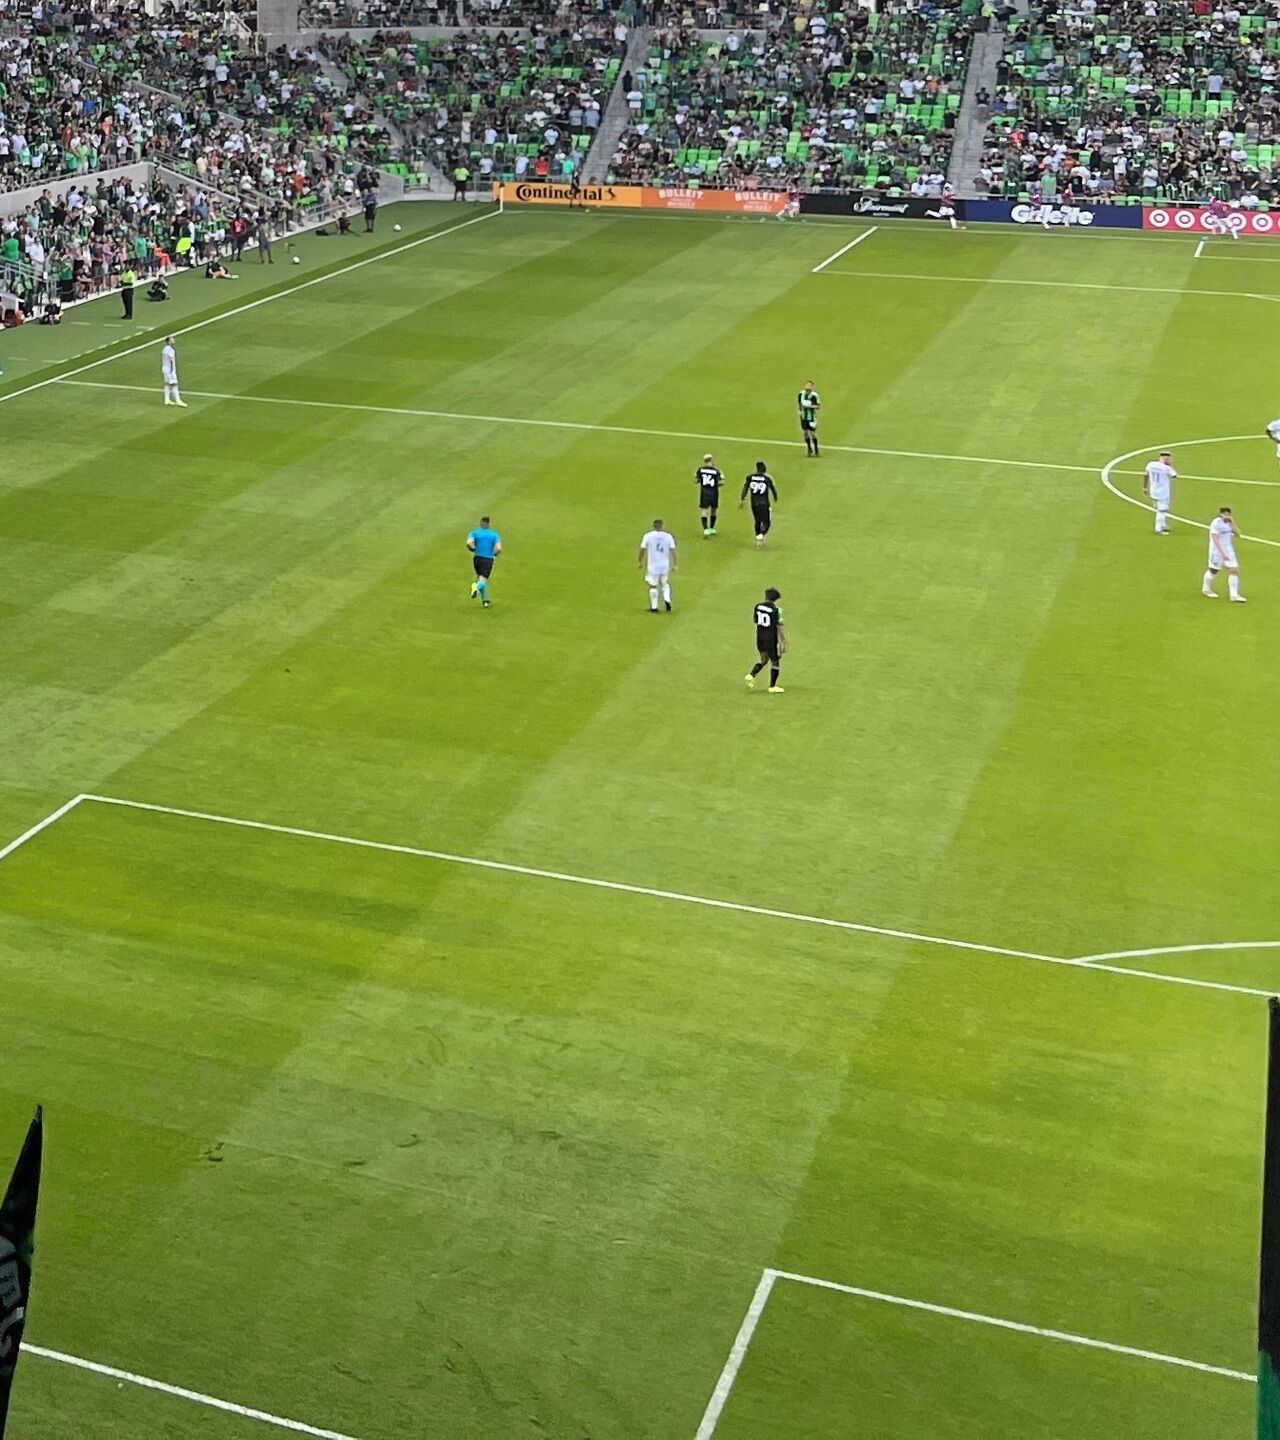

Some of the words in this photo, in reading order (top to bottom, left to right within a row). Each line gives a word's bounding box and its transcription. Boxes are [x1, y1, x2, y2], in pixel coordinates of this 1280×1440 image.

[516, 184, 602, 201] Continetal
[701, 473, 716, 488] 14
[749, 480, 768, 495] 99
[756, 610, 771, 627] 10
